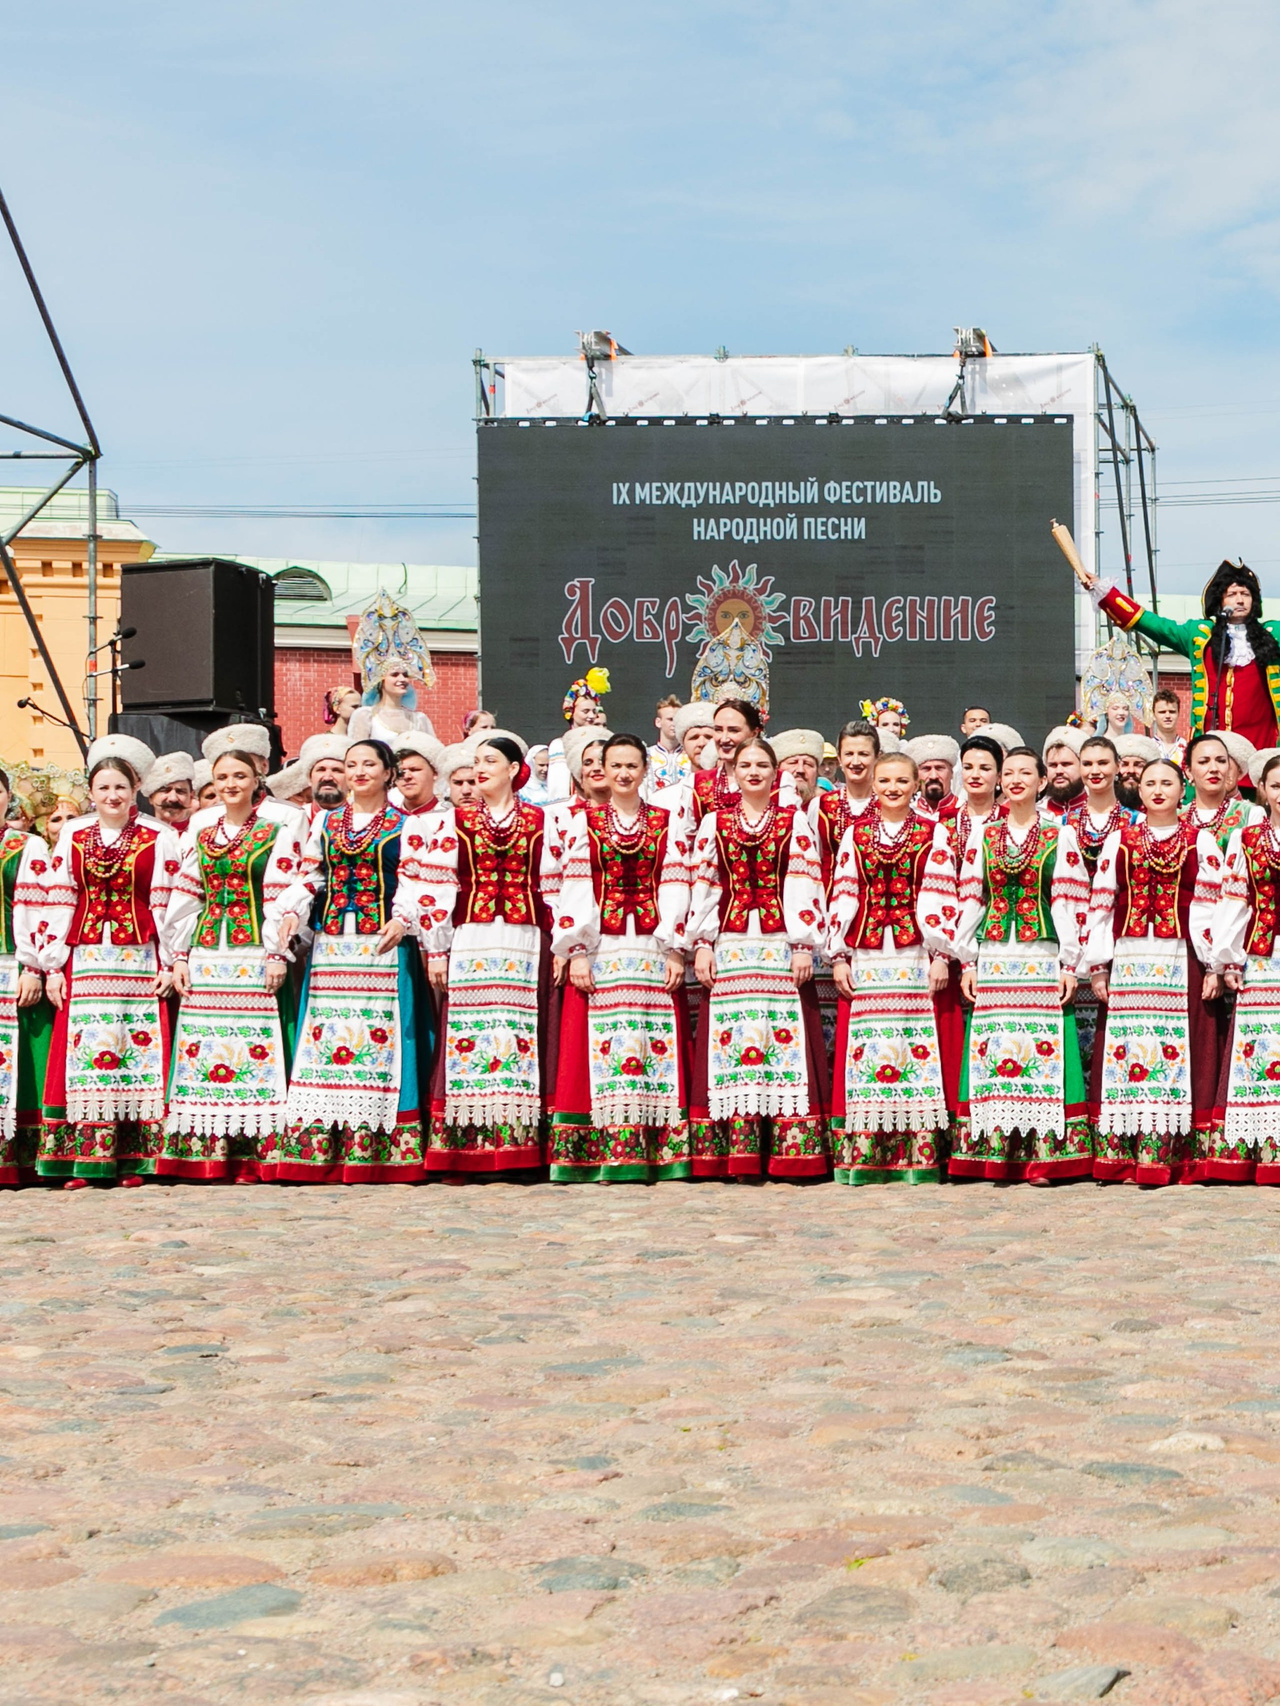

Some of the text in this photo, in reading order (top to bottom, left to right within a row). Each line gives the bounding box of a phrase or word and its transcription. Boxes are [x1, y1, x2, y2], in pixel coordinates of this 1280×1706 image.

[634, 477, 820, 508] МЕЖДУНАРОДНЫЙ
[823, 480, 942, 505] ФЕСТИВАЛЬ
[692, 513, 867, 544] НАРОДНОЙ ПЕСНИ
